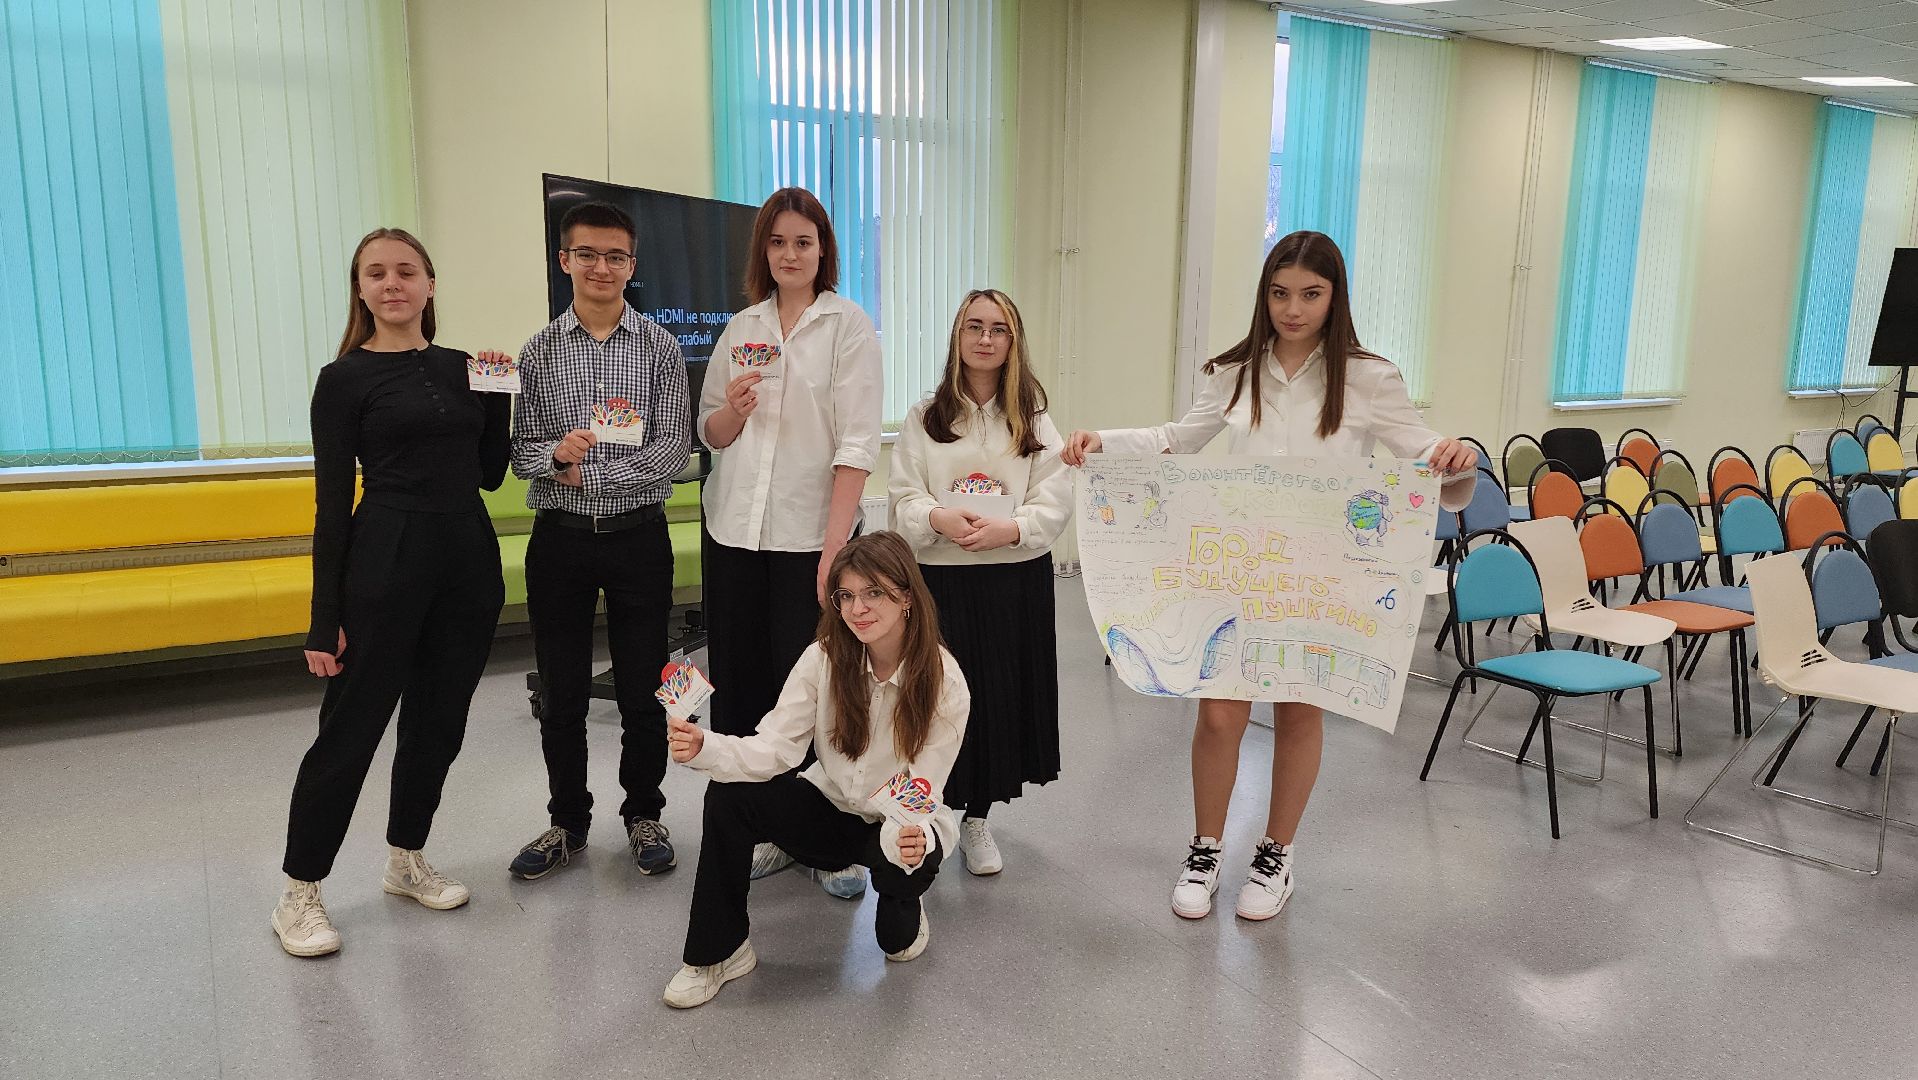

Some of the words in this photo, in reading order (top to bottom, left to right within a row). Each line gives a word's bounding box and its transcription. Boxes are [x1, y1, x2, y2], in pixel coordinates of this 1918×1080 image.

[656, 308, 684, 324] HDMI
[686, 312, 698, 323] не
[700, 312, 736, 326] подклю
[677, 330, 712, 345] слабый
